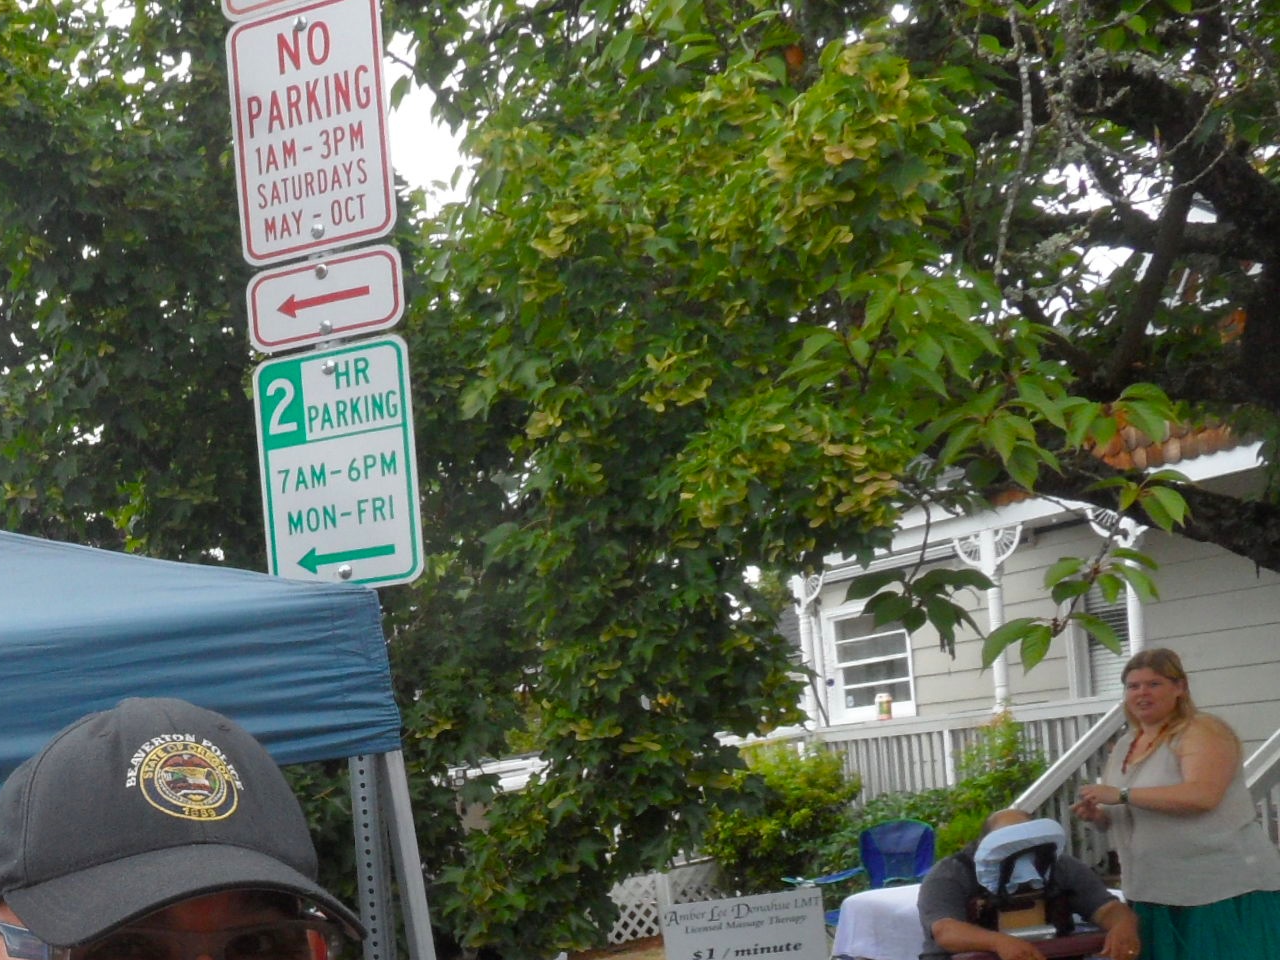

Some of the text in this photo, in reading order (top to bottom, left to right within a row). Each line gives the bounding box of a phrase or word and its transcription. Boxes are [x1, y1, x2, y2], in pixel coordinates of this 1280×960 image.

[277, 20, 331, 76] NO
[247, 64, 372, 139] PARKING
[257, 158, 368, 210] SATURDAYS
[264, 209, 304, 243] MAY
[330, 194, 367, 227] OCT
[265, 356, 371, 436] 2 HR
[307, 390, 399, 434] PARKING
[125, 733, 245, 791] BEAVERTON POLICE
[143, 747, 168, 780] STATE
[664, 910, 706, 928] Amber
[726, 919, 764, 931] Massage
[769, 914, 807, 926] Therapy
